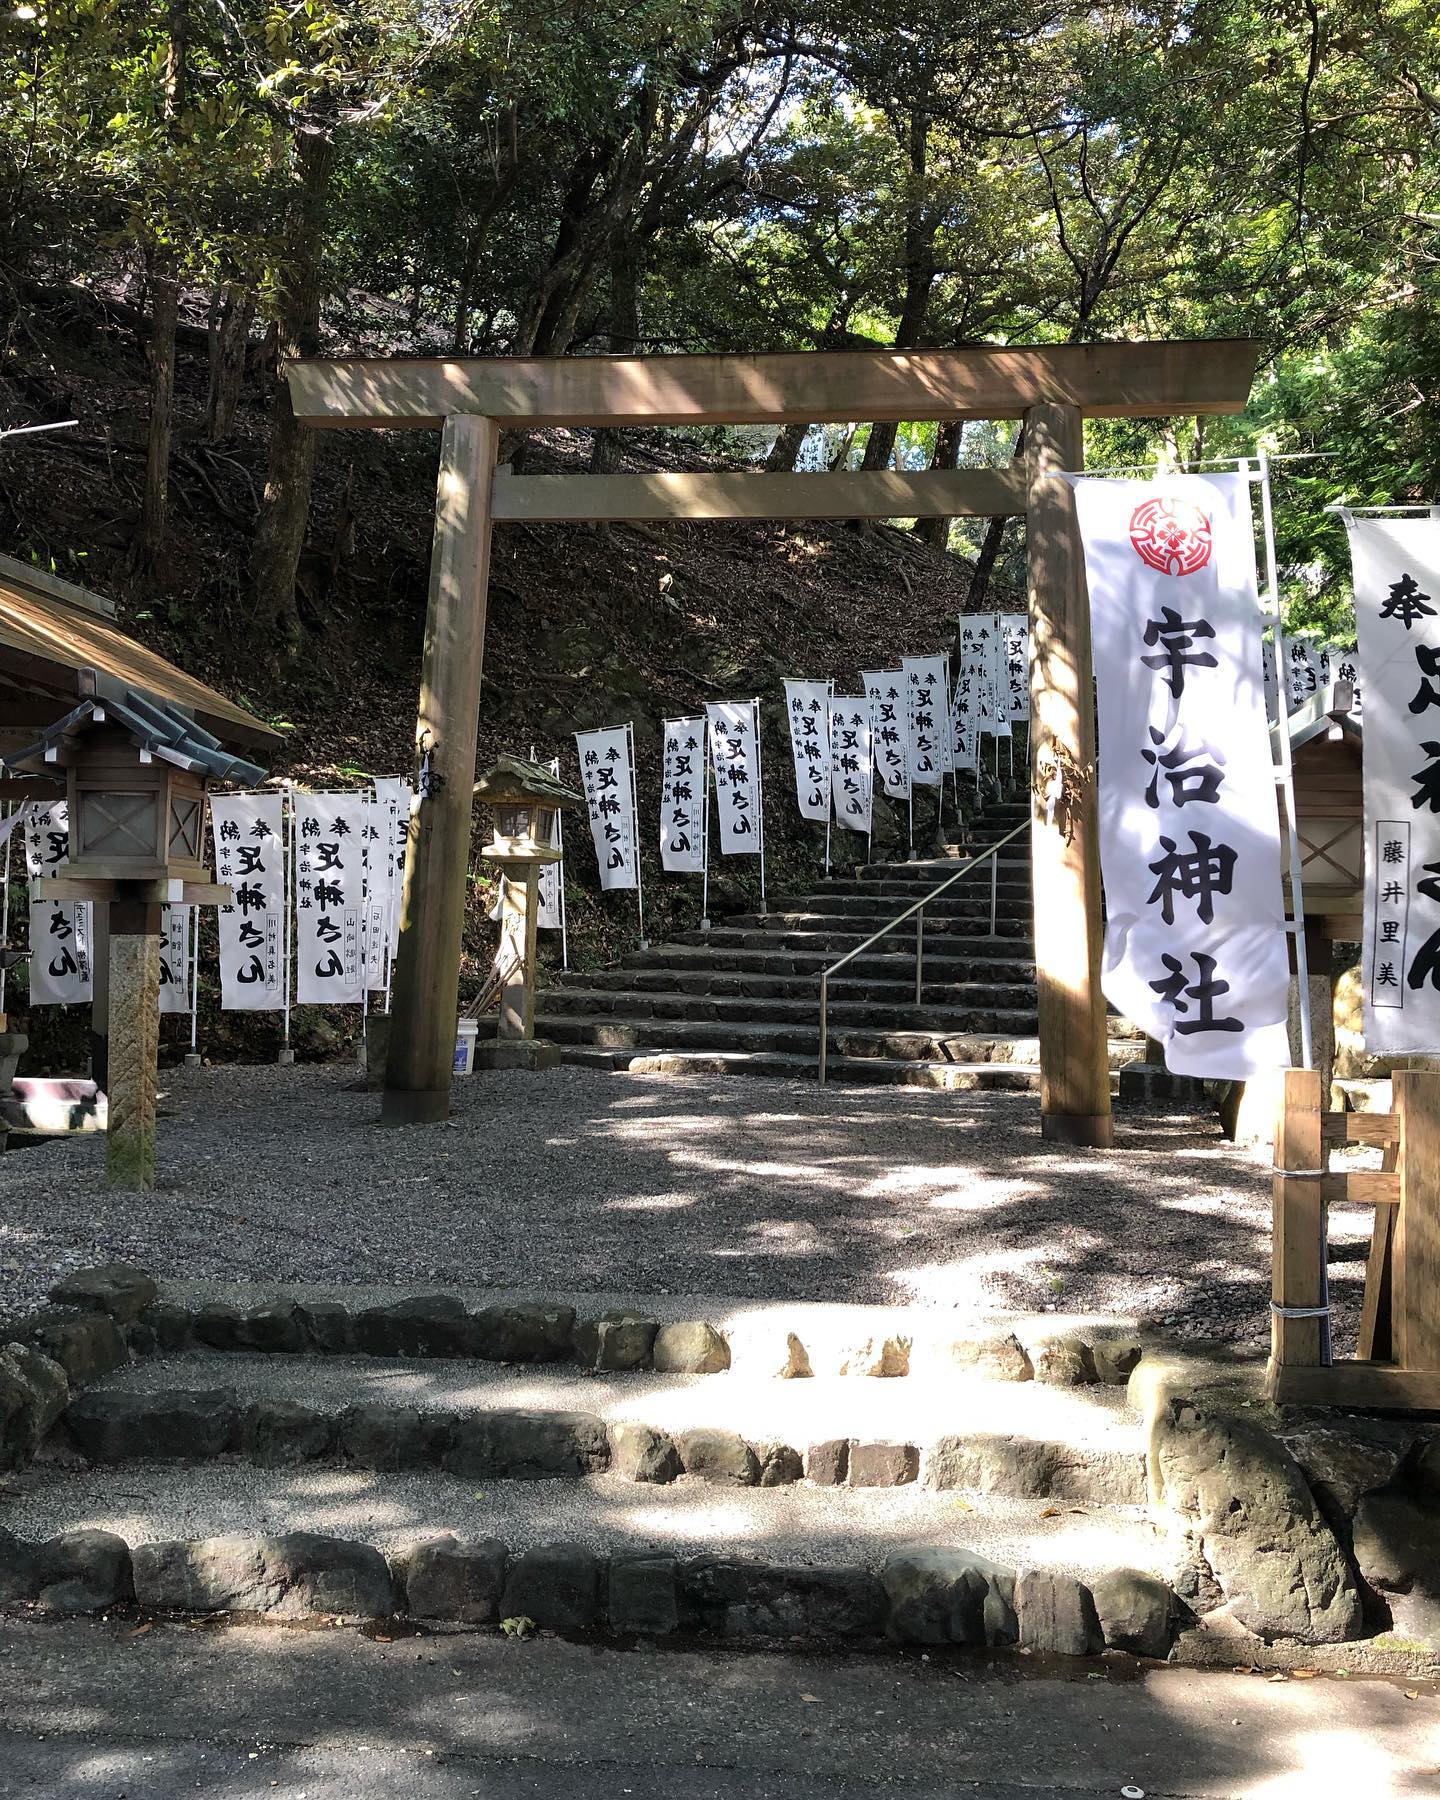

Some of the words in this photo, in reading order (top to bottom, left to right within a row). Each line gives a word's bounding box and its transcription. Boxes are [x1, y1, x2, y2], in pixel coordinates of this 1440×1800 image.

[1379, 573, 1438, 630] 奉
[1140, 605, 1245, 1036] 宇治神社
[1376, 839, 1405, 987] 藤井里美
